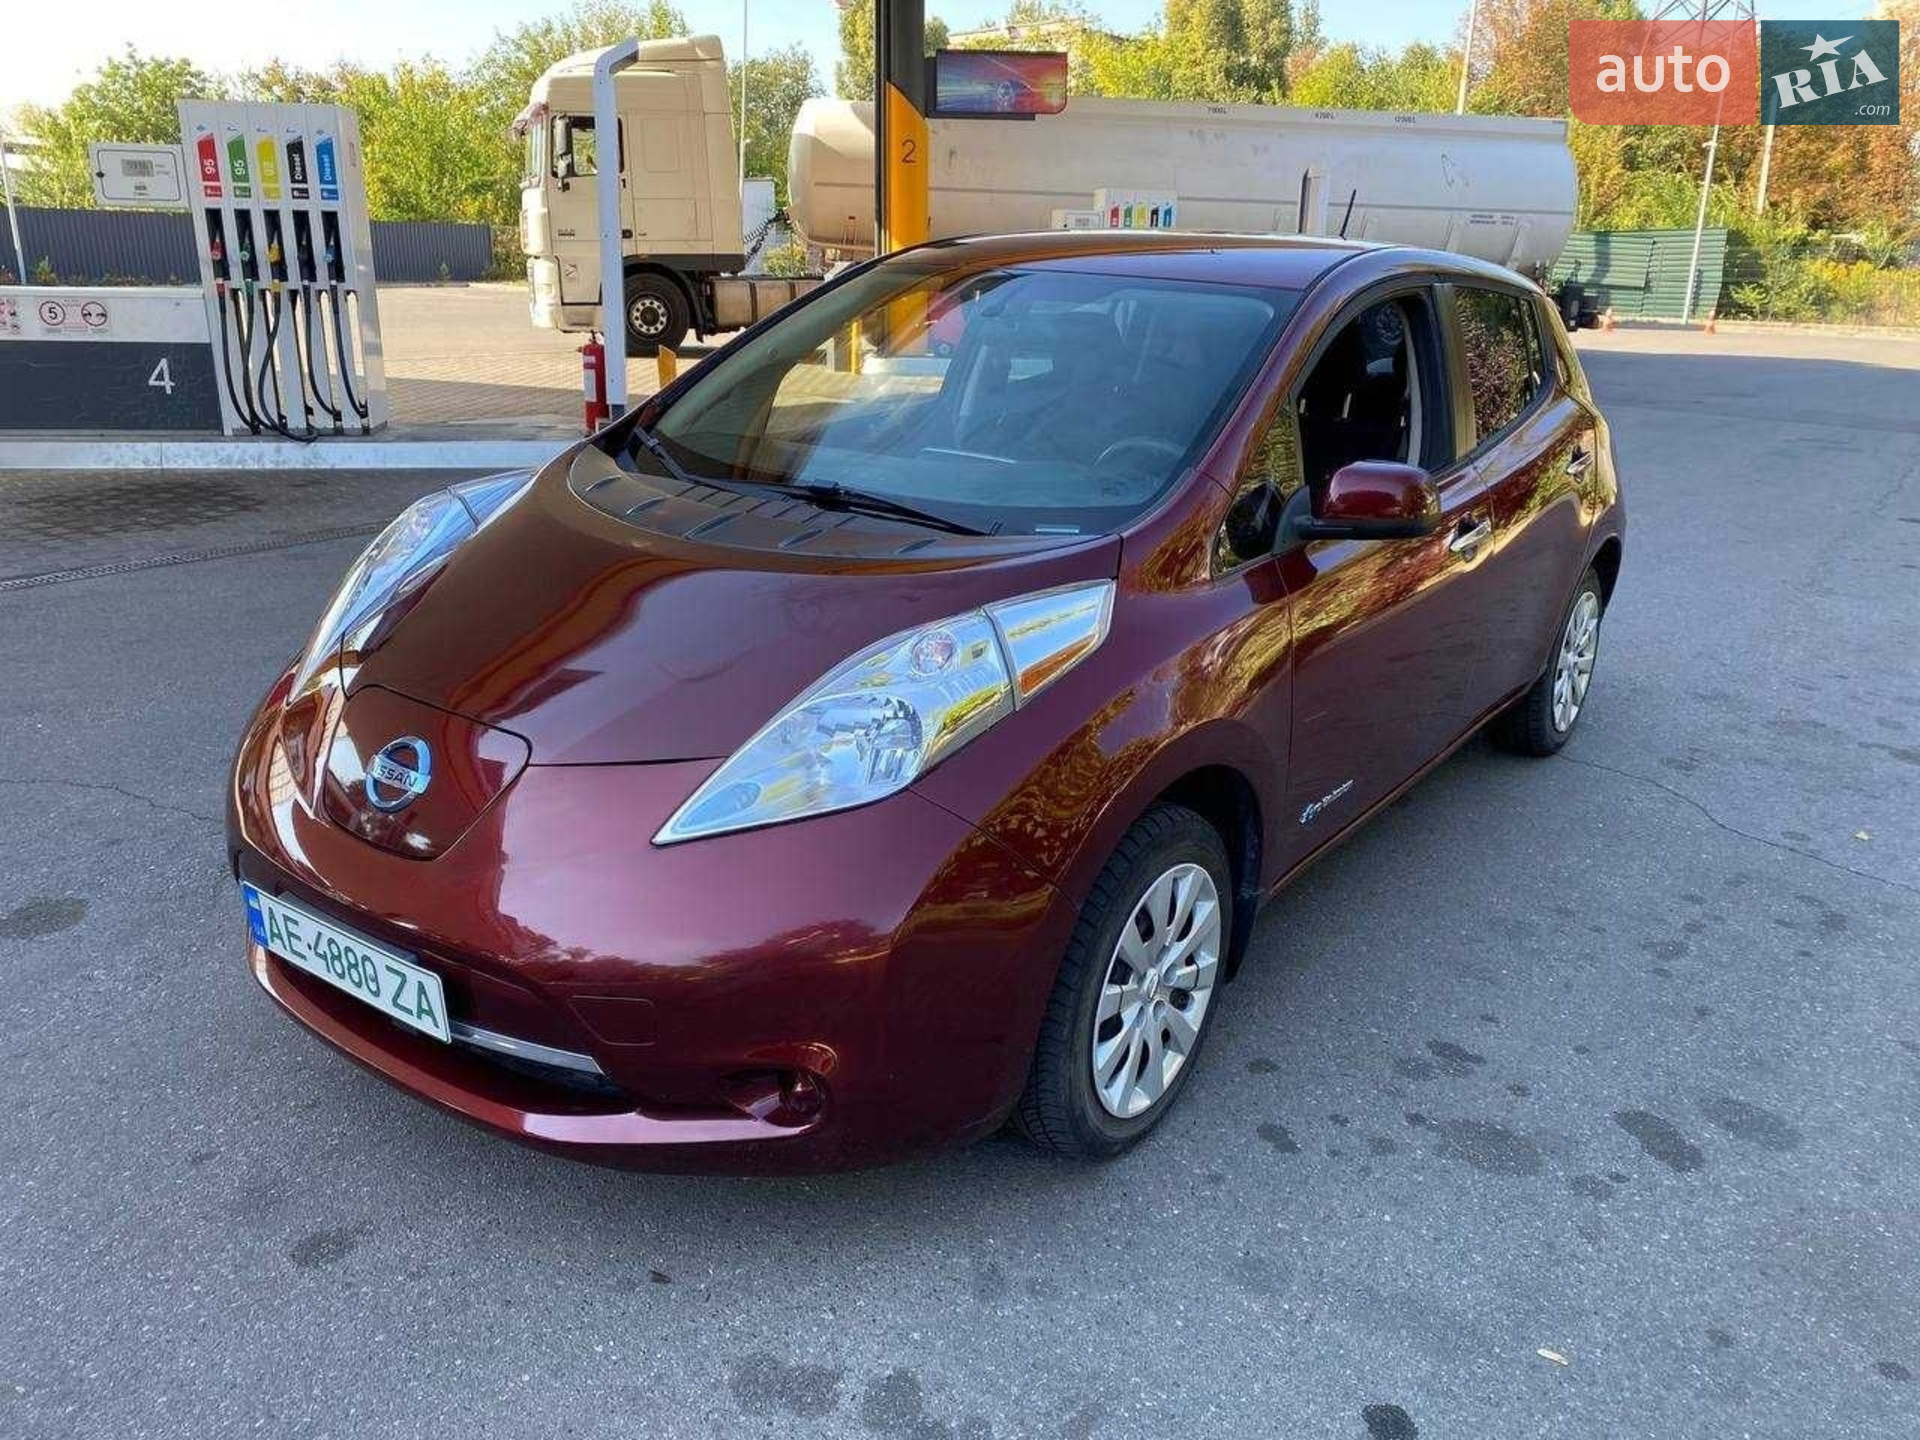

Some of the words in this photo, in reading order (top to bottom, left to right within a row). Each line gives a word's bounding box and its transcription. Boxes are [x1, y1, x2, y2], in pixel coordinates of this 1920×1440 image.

[901, 138, 917, 164] 2
[203, 158, 217, 175] 95
[234, 159, 246, 176] 95
[293, 152, 303, 180] Diesel
[322, 153, 333, 181] Diesel
[48, 306, 58, 320] 5
[148, 358, 175, 394] 4
[266, 905, 307, 962] AE
[313, 930, 381, 998] 4880
[385, 964, 440, 1030] ZA
